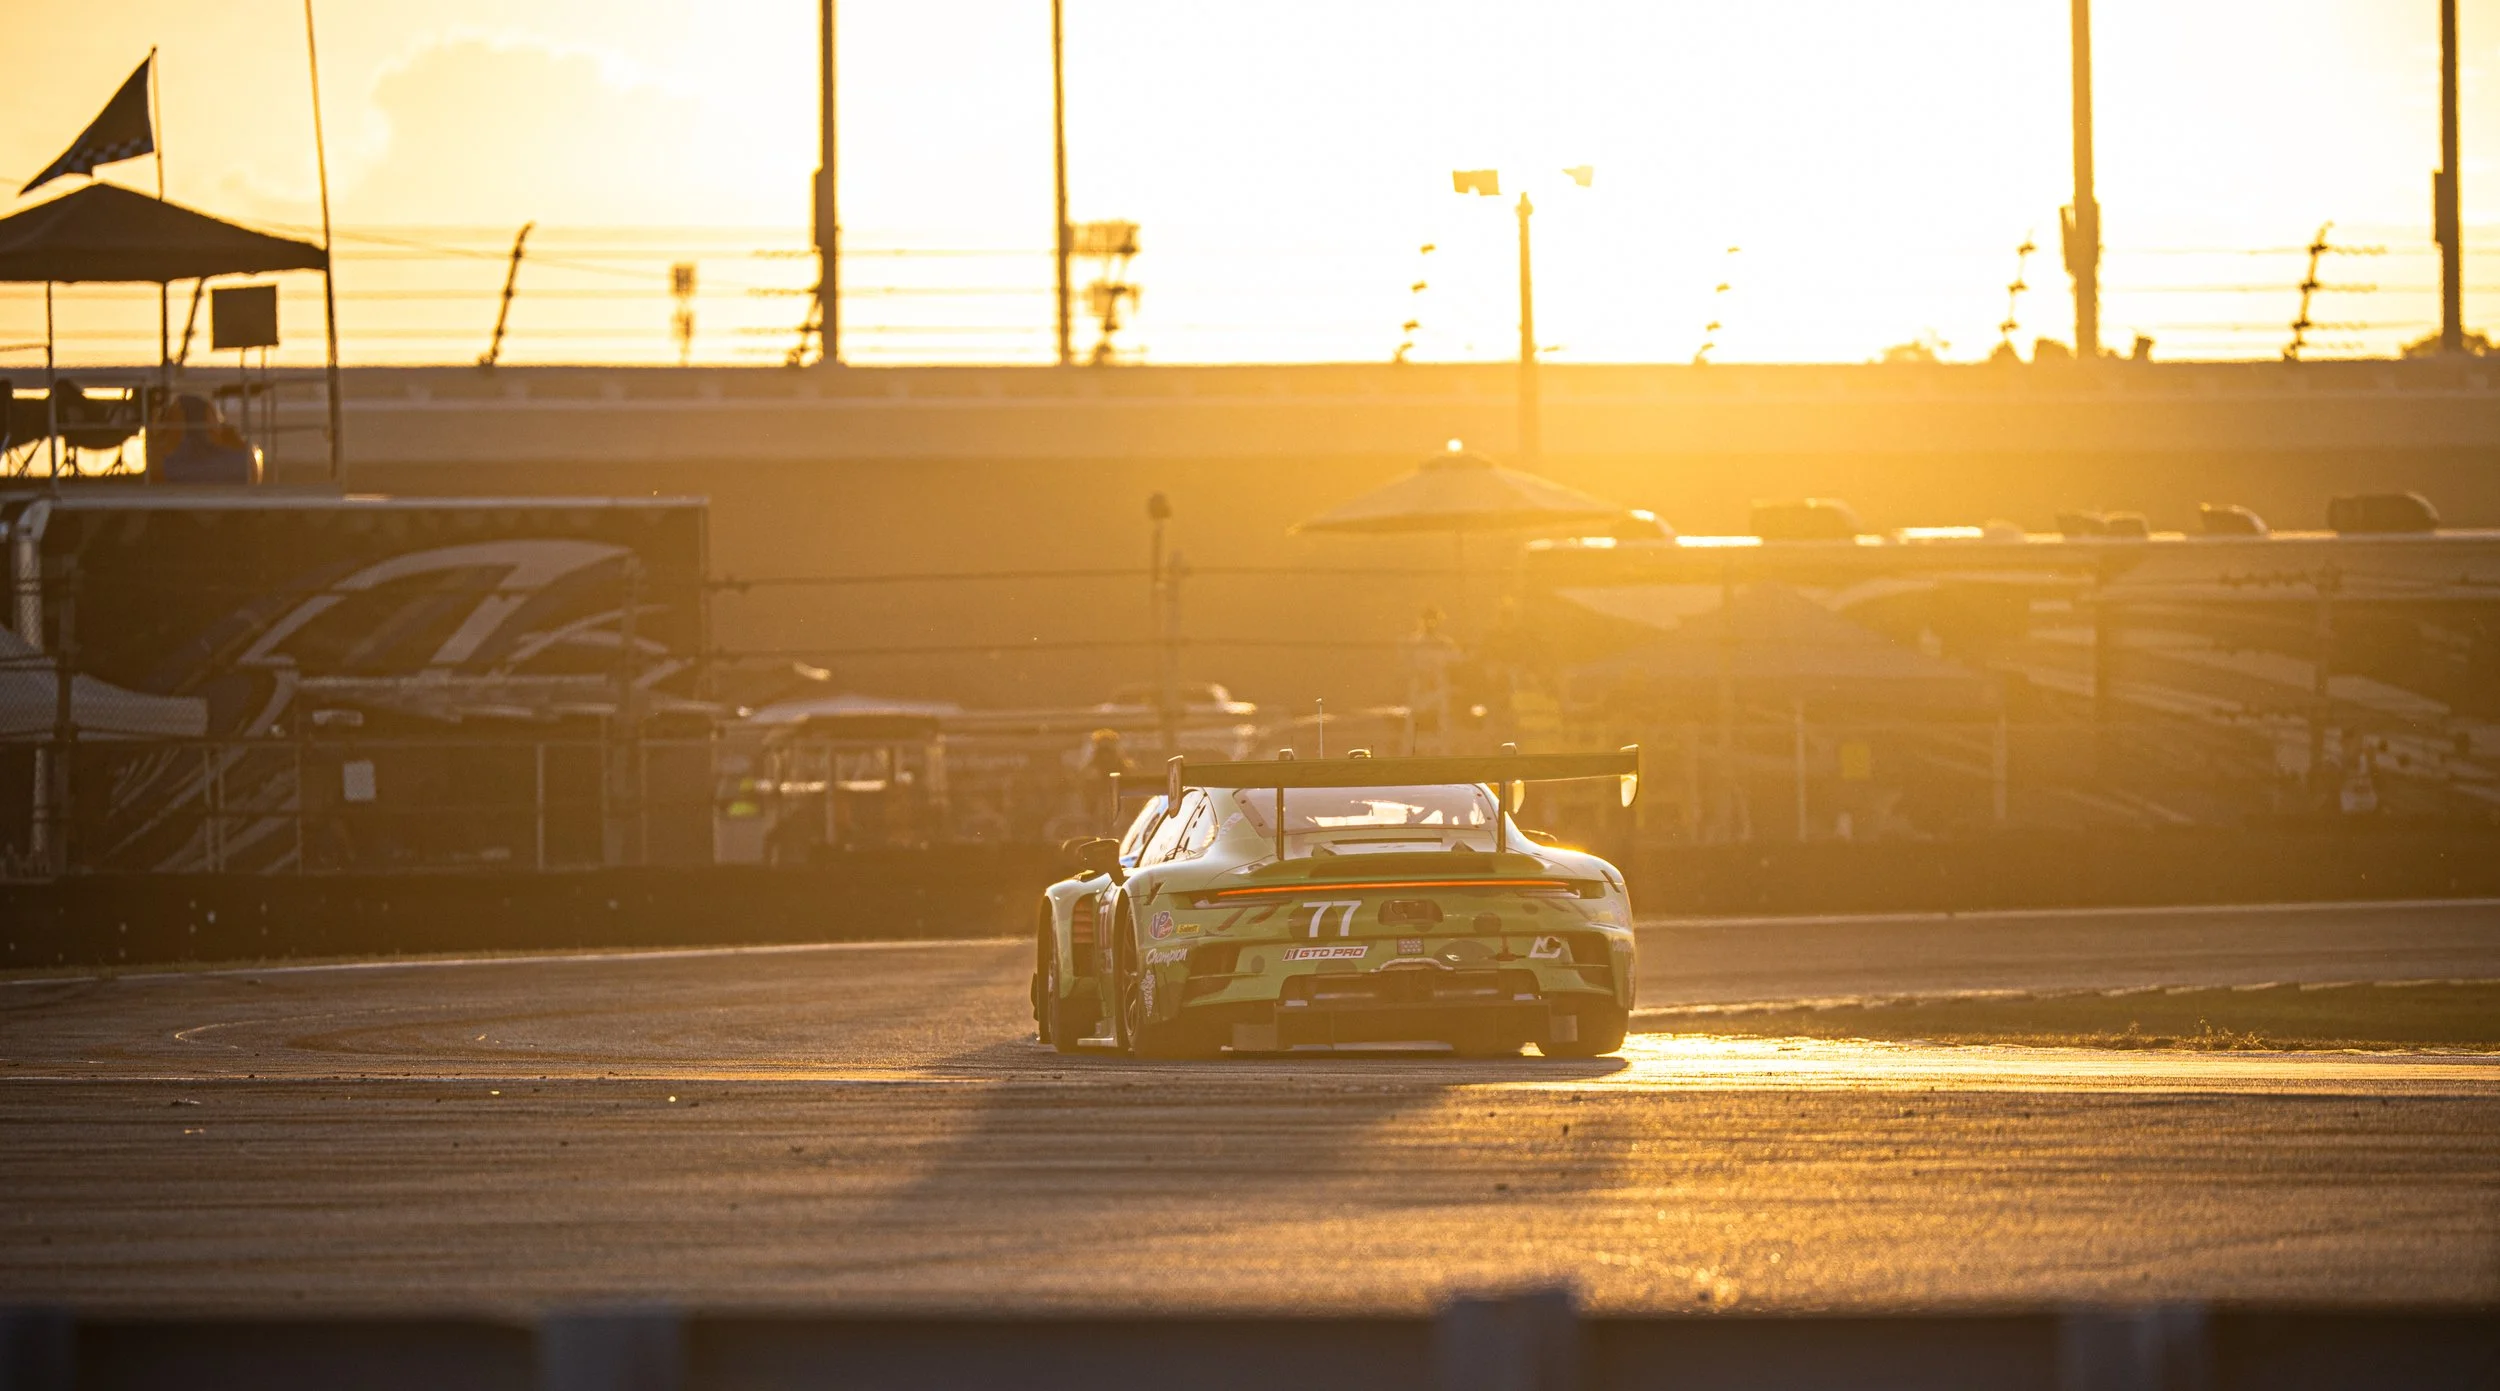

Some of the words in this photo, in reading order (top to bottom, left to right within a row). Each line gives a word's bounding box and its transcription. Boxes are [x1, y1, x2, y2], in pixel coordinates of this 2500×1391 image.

[1303, 900, 1362, 938] 77
[1146, 948, 1188, 967] Champion
[1299, 948, 1330, 958] GTD
[1332, 947, 1365, 957] PRO
